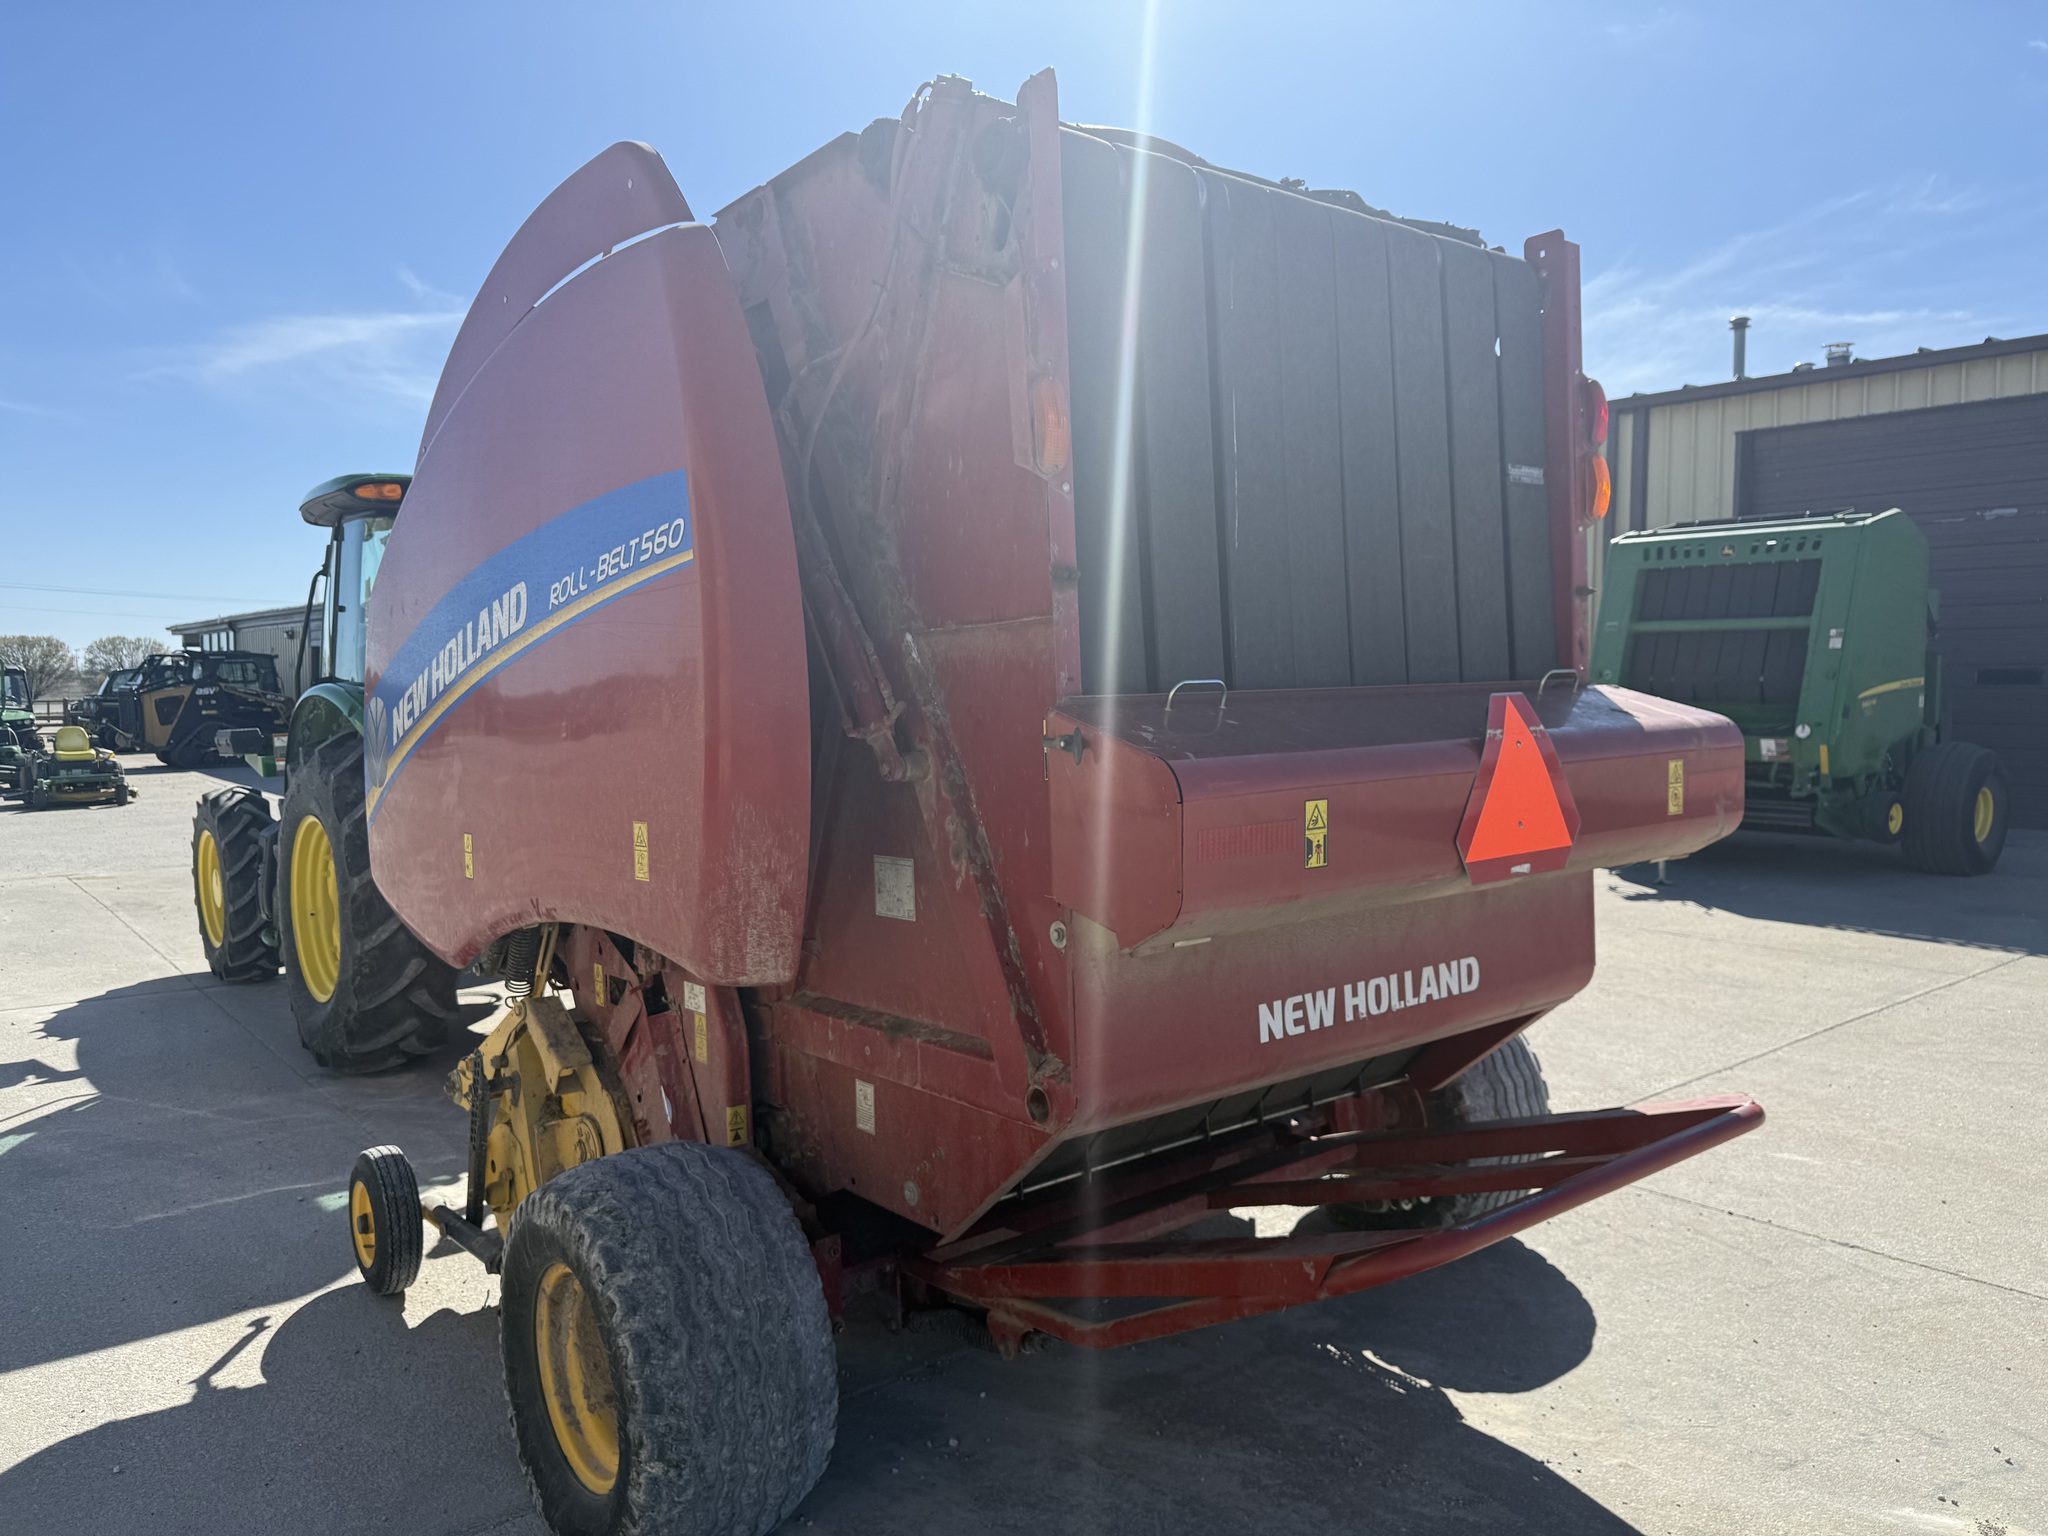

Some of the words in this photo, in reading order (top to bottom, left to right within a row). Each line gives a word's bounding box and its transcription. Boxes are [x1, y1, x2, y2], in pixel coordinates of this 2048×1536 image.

[640, 518, 685, 561] 560
[392, 667, 428, 746] NEW
[432, 581, 527, 700] HOLLAND
[1258, 987, 1336, 1044] NEW
[1343, 956, 1480, 1022] HOLLAND
